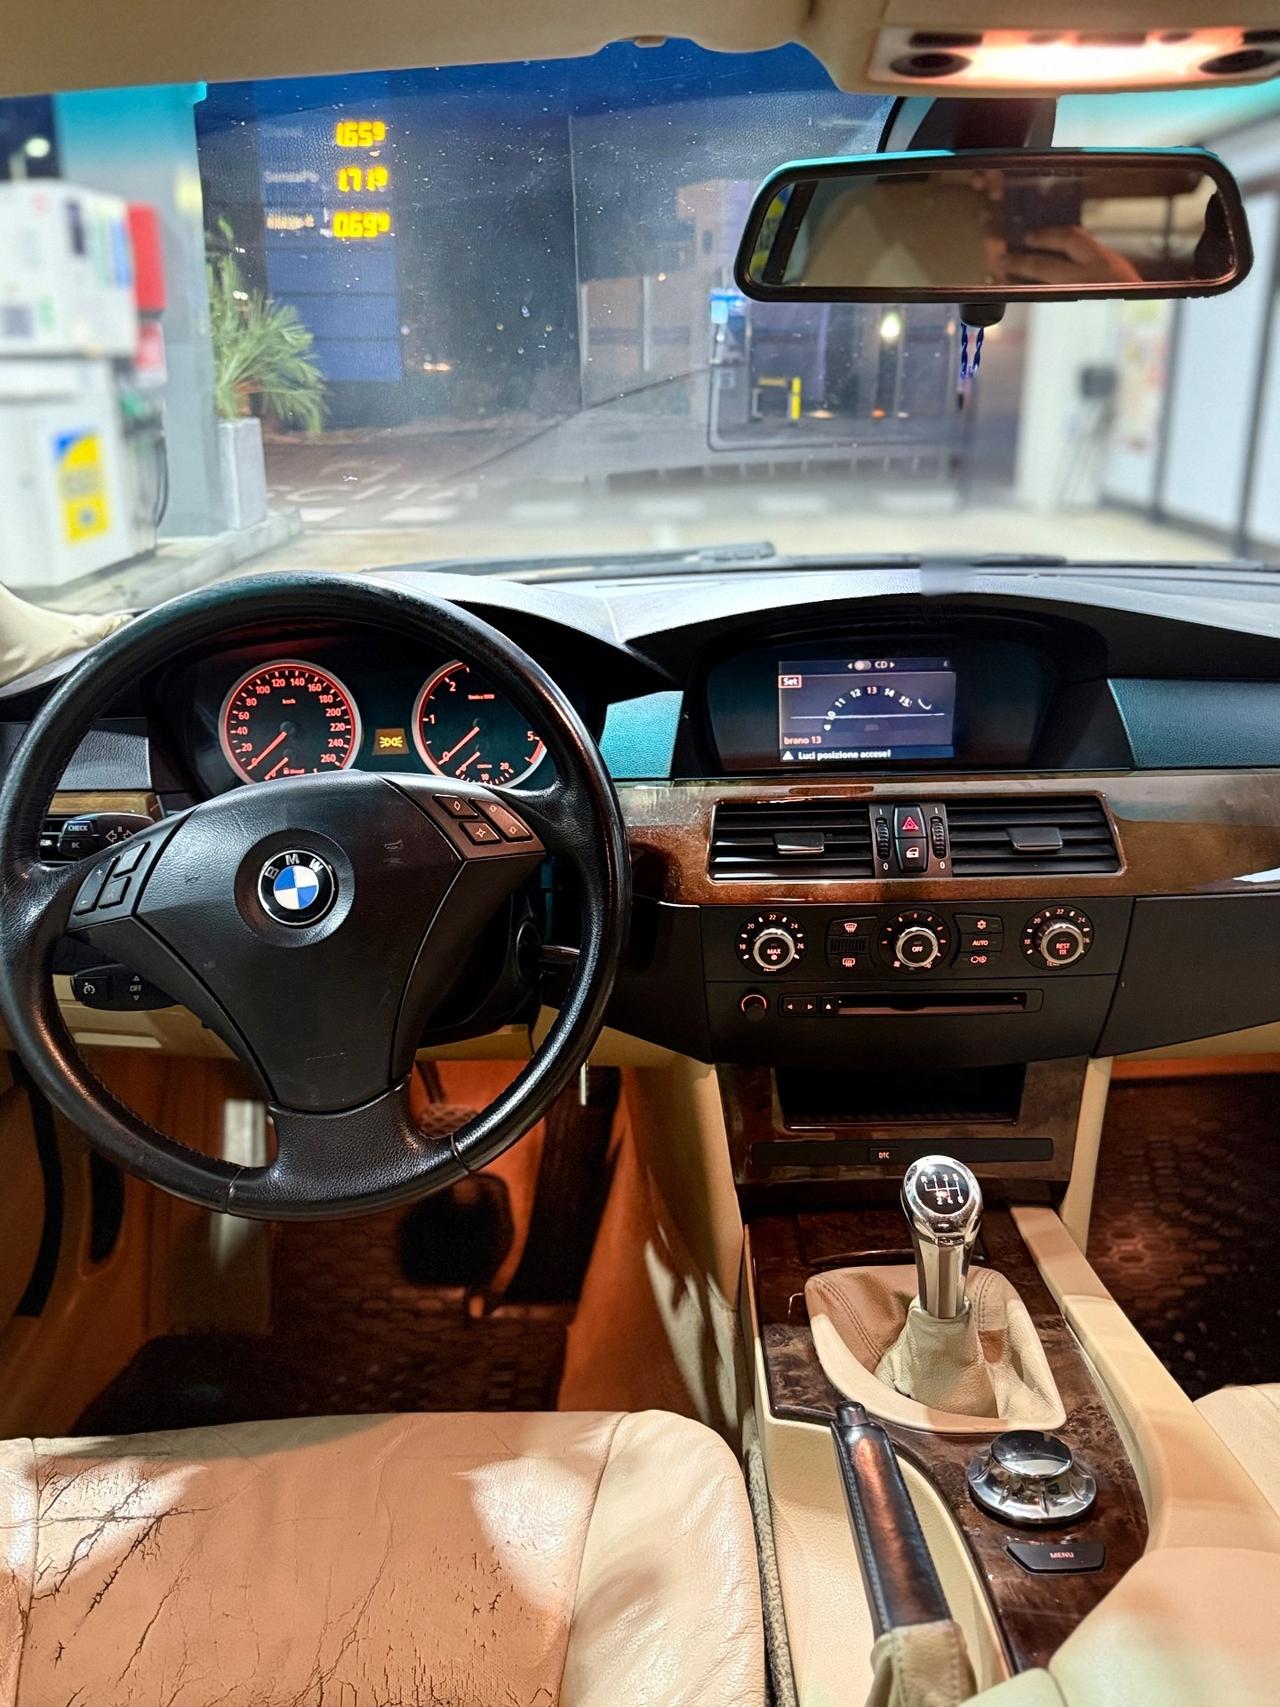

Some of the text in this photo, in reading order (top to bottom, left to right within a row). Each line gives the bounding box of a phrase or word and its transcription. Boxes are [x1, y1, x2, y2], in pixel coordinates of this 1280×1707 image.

[875, 660, 888, 669] CD
[290, 678, 305, 687] 140
[450, 681, 456, 691] 2
[256, 686, 271, 694] 100
[307, 684, 321, 692] 160
[867, 686, 877, 694] 13
[850, 689, 861, 698] 12
[246, 698, 257, 706] 80
[319, 695, 334, 703] 180
[238, 712, 249, 720] 60
[326, 708, 341, 717] 200
[430, 714, 435, 724] 1
[236, 726, 248, 735] 40
[330, 722, 345, 732] 220
[527, 731, 534, 741] 5
[811, 736, 822, 744] 13
[241, 743, 252, 752] 20
[328, 739, 343, 747] 240
[321, 754, 336, 763] 260
[798, 752, 815, 760] Luci
[264, 853, 324, 880] BMW
